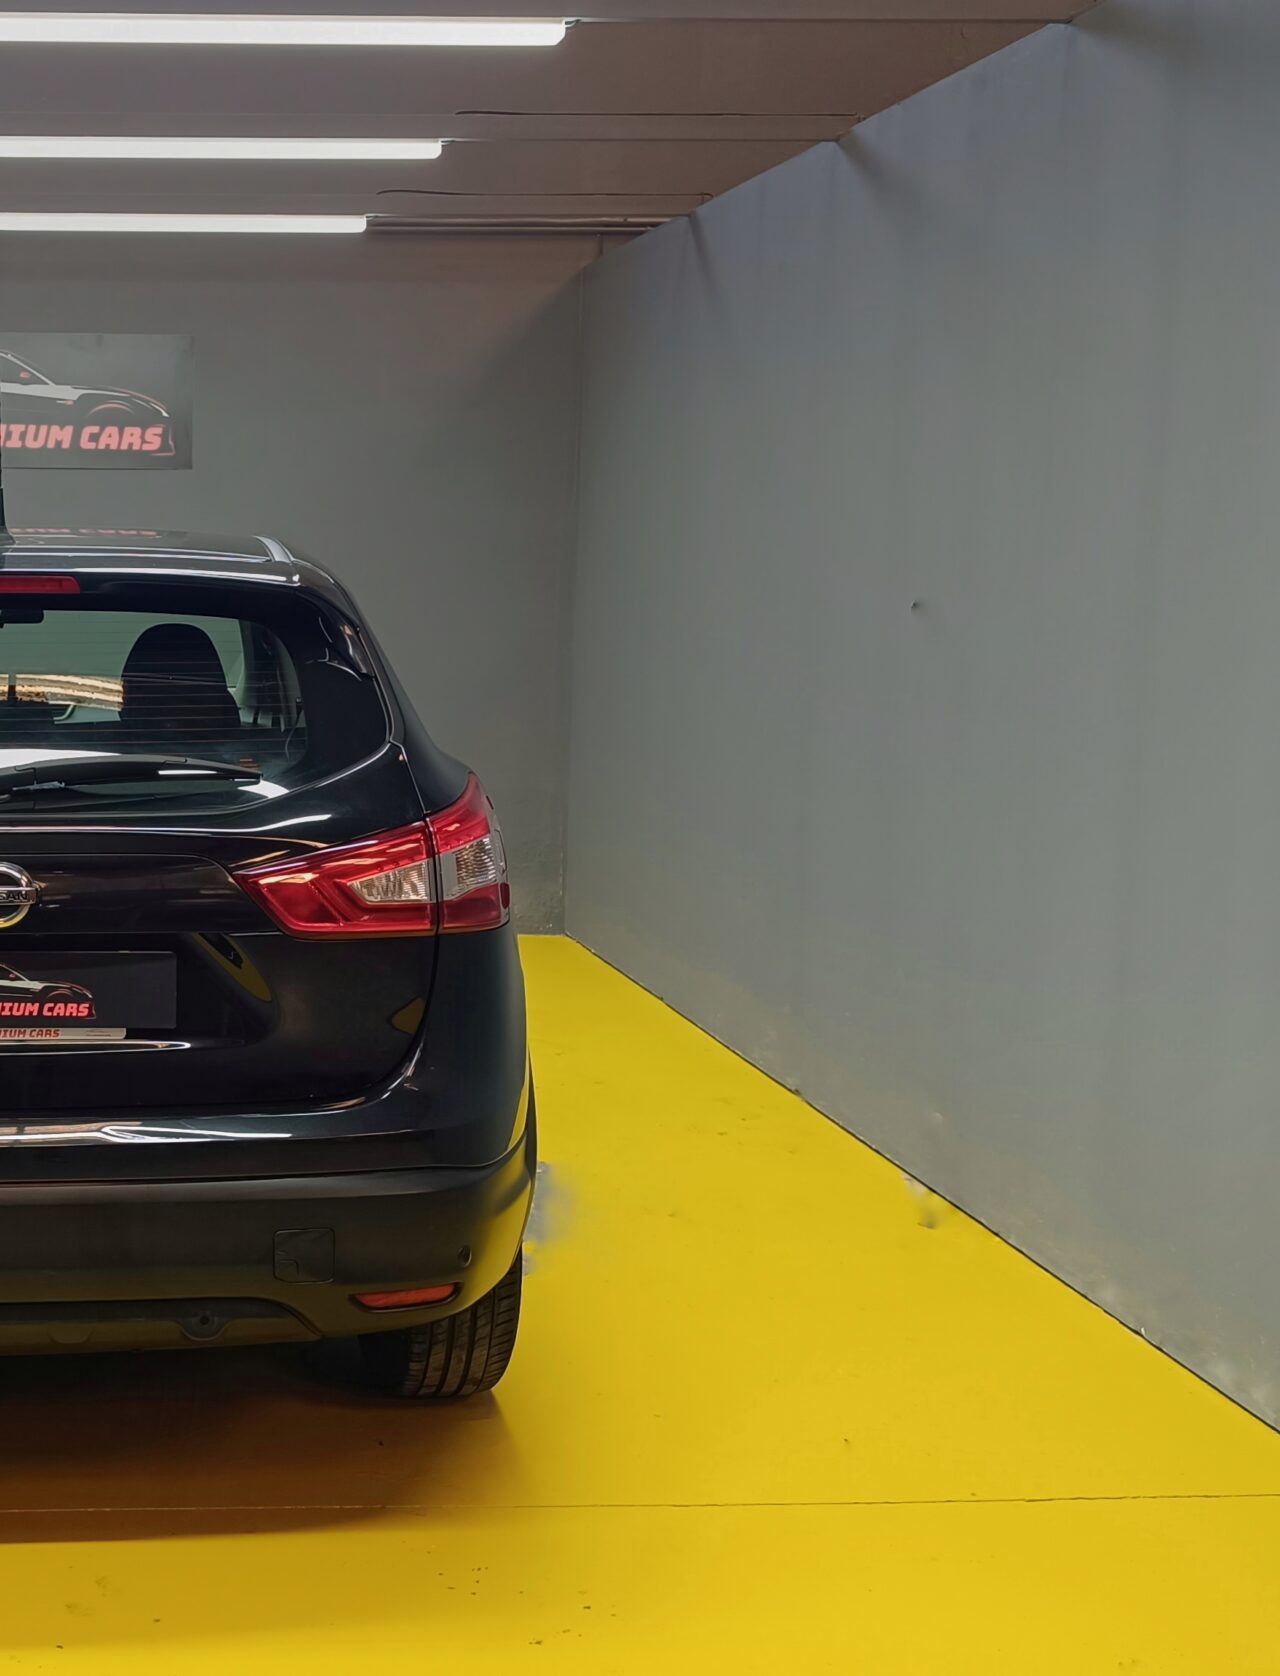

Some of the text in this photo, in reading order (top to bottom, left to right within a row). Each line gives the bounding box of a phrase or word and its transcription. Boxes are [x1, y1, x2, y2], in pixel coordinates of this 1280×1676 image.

[79, 424, 163, 451] CARS
[42, 1002, 90, 1018] CARS
[29, 1029, 60, 1038] CARS
